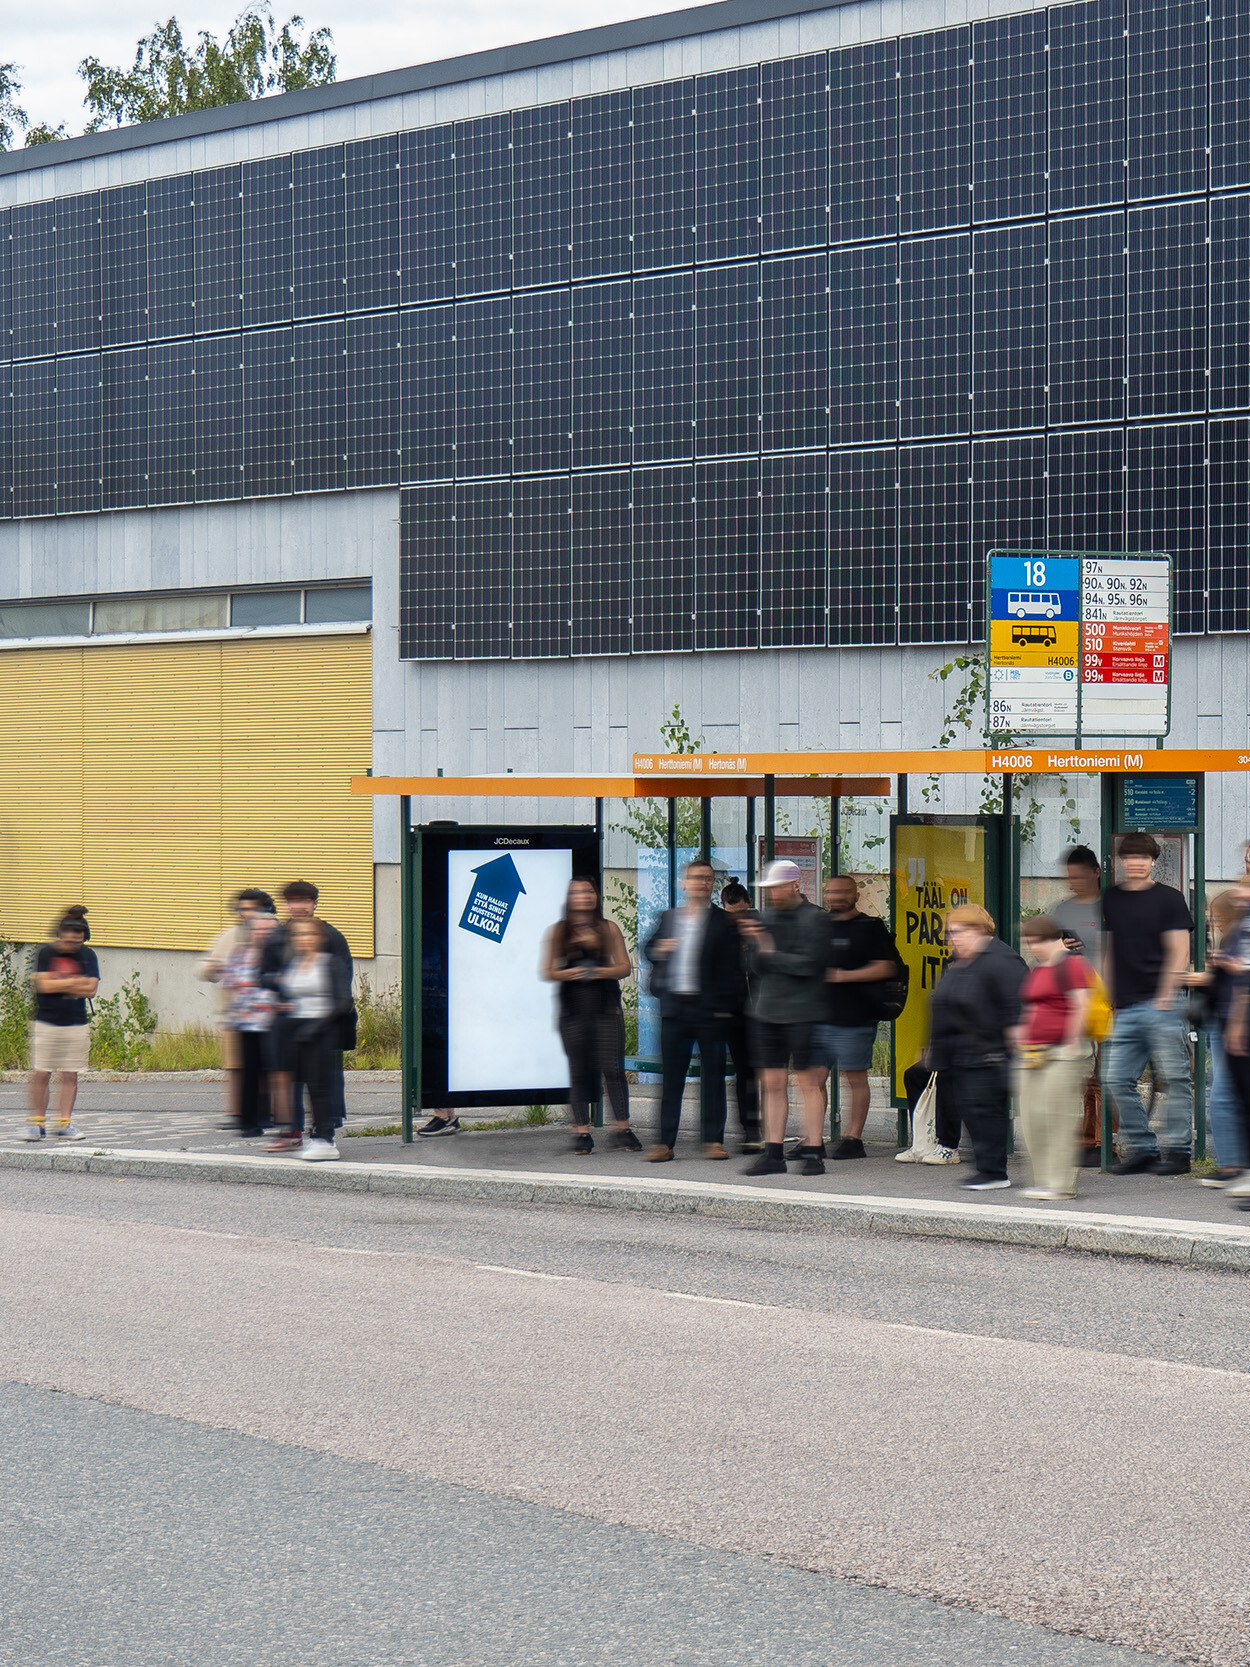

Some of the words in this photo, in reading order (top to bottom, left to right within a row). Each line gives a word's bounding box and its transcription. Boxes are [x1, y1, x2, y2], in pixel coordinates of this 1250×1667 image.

[1024, 561, 1046, 586] 18
[1086, 562, 1102, 574] 97N
[1130, 578, 1148, 590] 92N
[1130, 594, 1148, 606] 96N
[1086, 608, 1107, 620] 841N
[1085, 623, 1106, 636] 500
[1085, 638, 1102, 651] 510
[1048, 656, 1074, 666] H4006
[1084, 654, 1102, 666] 99V
[1084, 670, 1104, 682] 99M
[993, 700, 1012, 712] 86N
[993, 716, 1010, 728] 87N
[634, 758, 653, 769] H4006
[992, 756, 1032, 767] H4006
[1048, 755, 1120, 767] Herttoniemi
[1124, 754, 1143, 769] (M)
[916, 882, 945, 908] TÄÄL
[951, 888, 968, 910] ON
[474, 898, 488, 909] ETTÄ
[488, 903, 506, 916] SINUT
[471, 906, 504, 922] MUISTETAAN
[906, 911, 949, 946] PAR
